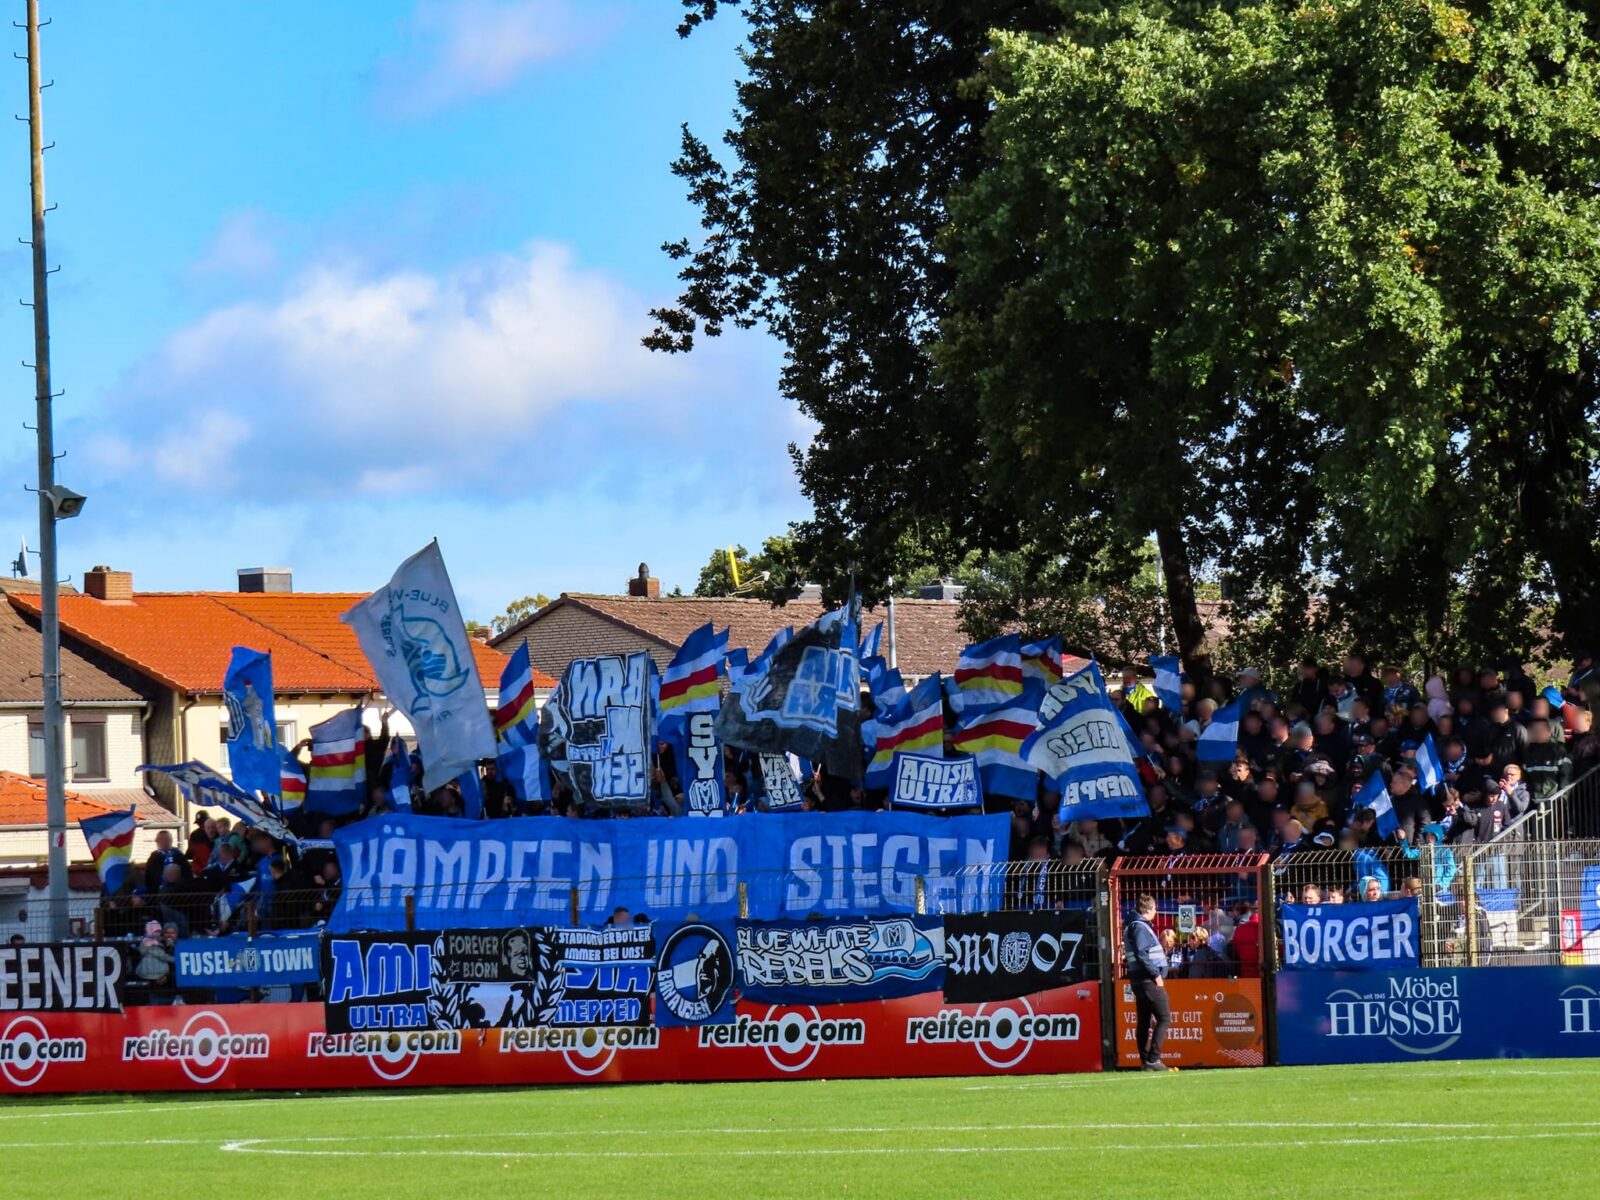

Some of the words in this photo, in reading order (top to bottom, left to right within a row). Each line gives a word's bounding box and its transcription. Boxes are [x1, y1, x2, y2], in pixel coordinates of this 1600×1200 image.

[345, 824, 613, 913] KÄMPFEN
[645, 838, 739, 907] UND
[785, 834, 996, 910] SIEGEN
[449, 935, 499, 955] FOREVER
[1283, 907, 1415, 964] BÖRGER
[180, 950, 232, 976] FUSEL
[260, 947, 314, 973] TOWN
[564, 948, 600, 960] IMMER
[603, 947, 619, 960] BEI
[1388, 975, 1459, 999] Möbel
[350, 1003, 428, 1030] ULTRA
[553, 997, 641, 1024] MEPPEN
[1325, 1000, 1462, 1036] HESSE
